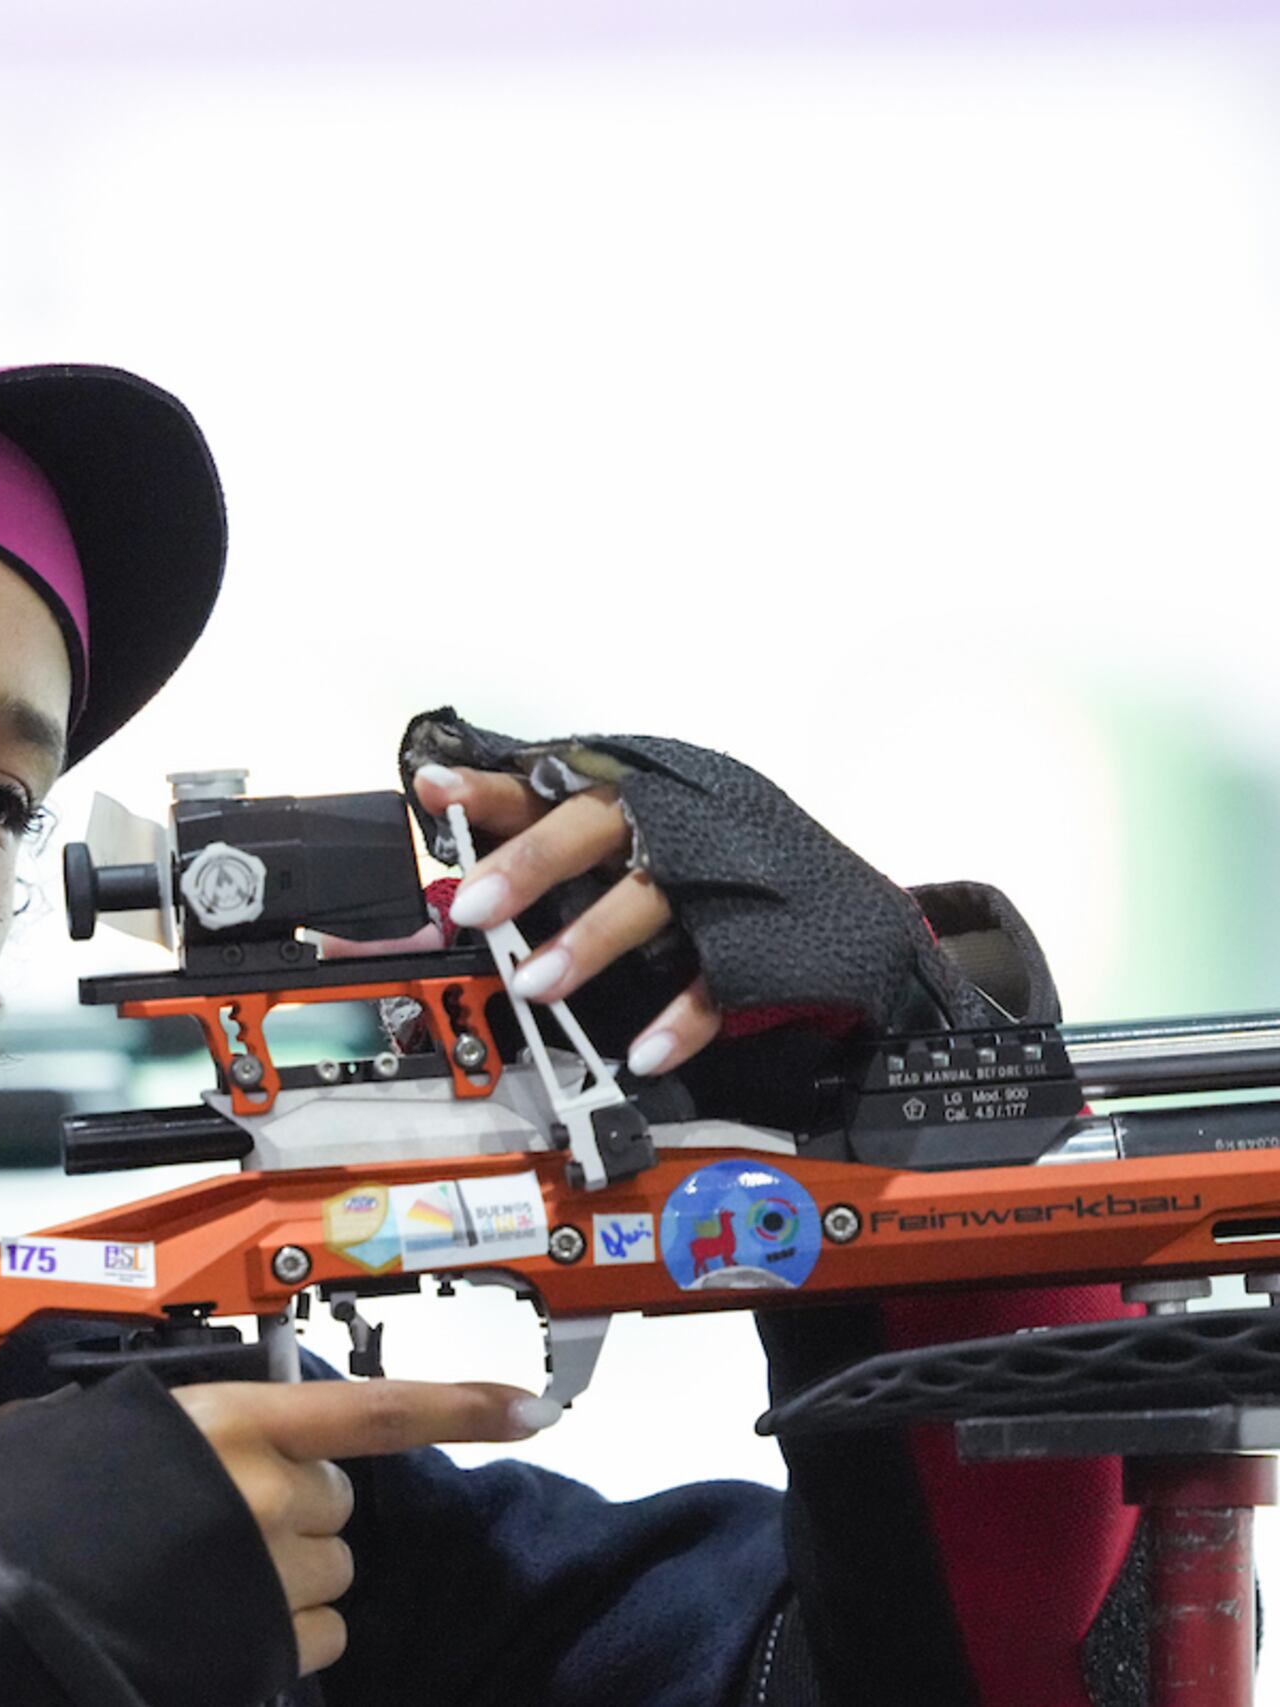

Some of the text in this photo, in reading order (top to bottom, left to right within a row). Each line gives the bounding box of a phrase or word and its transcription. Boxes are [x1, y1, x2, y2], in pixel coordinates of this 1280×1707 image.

[888, 1062, 1048, 1087] READ MANUAL BEFORE USE
[1005, 1087, 1030, 1101] 900
[944, 1107, 970, 1122] Cal.
[870, 1193, 1202, 1234] Feinwerkbau
[6, 1244, 57, 1273] 175
